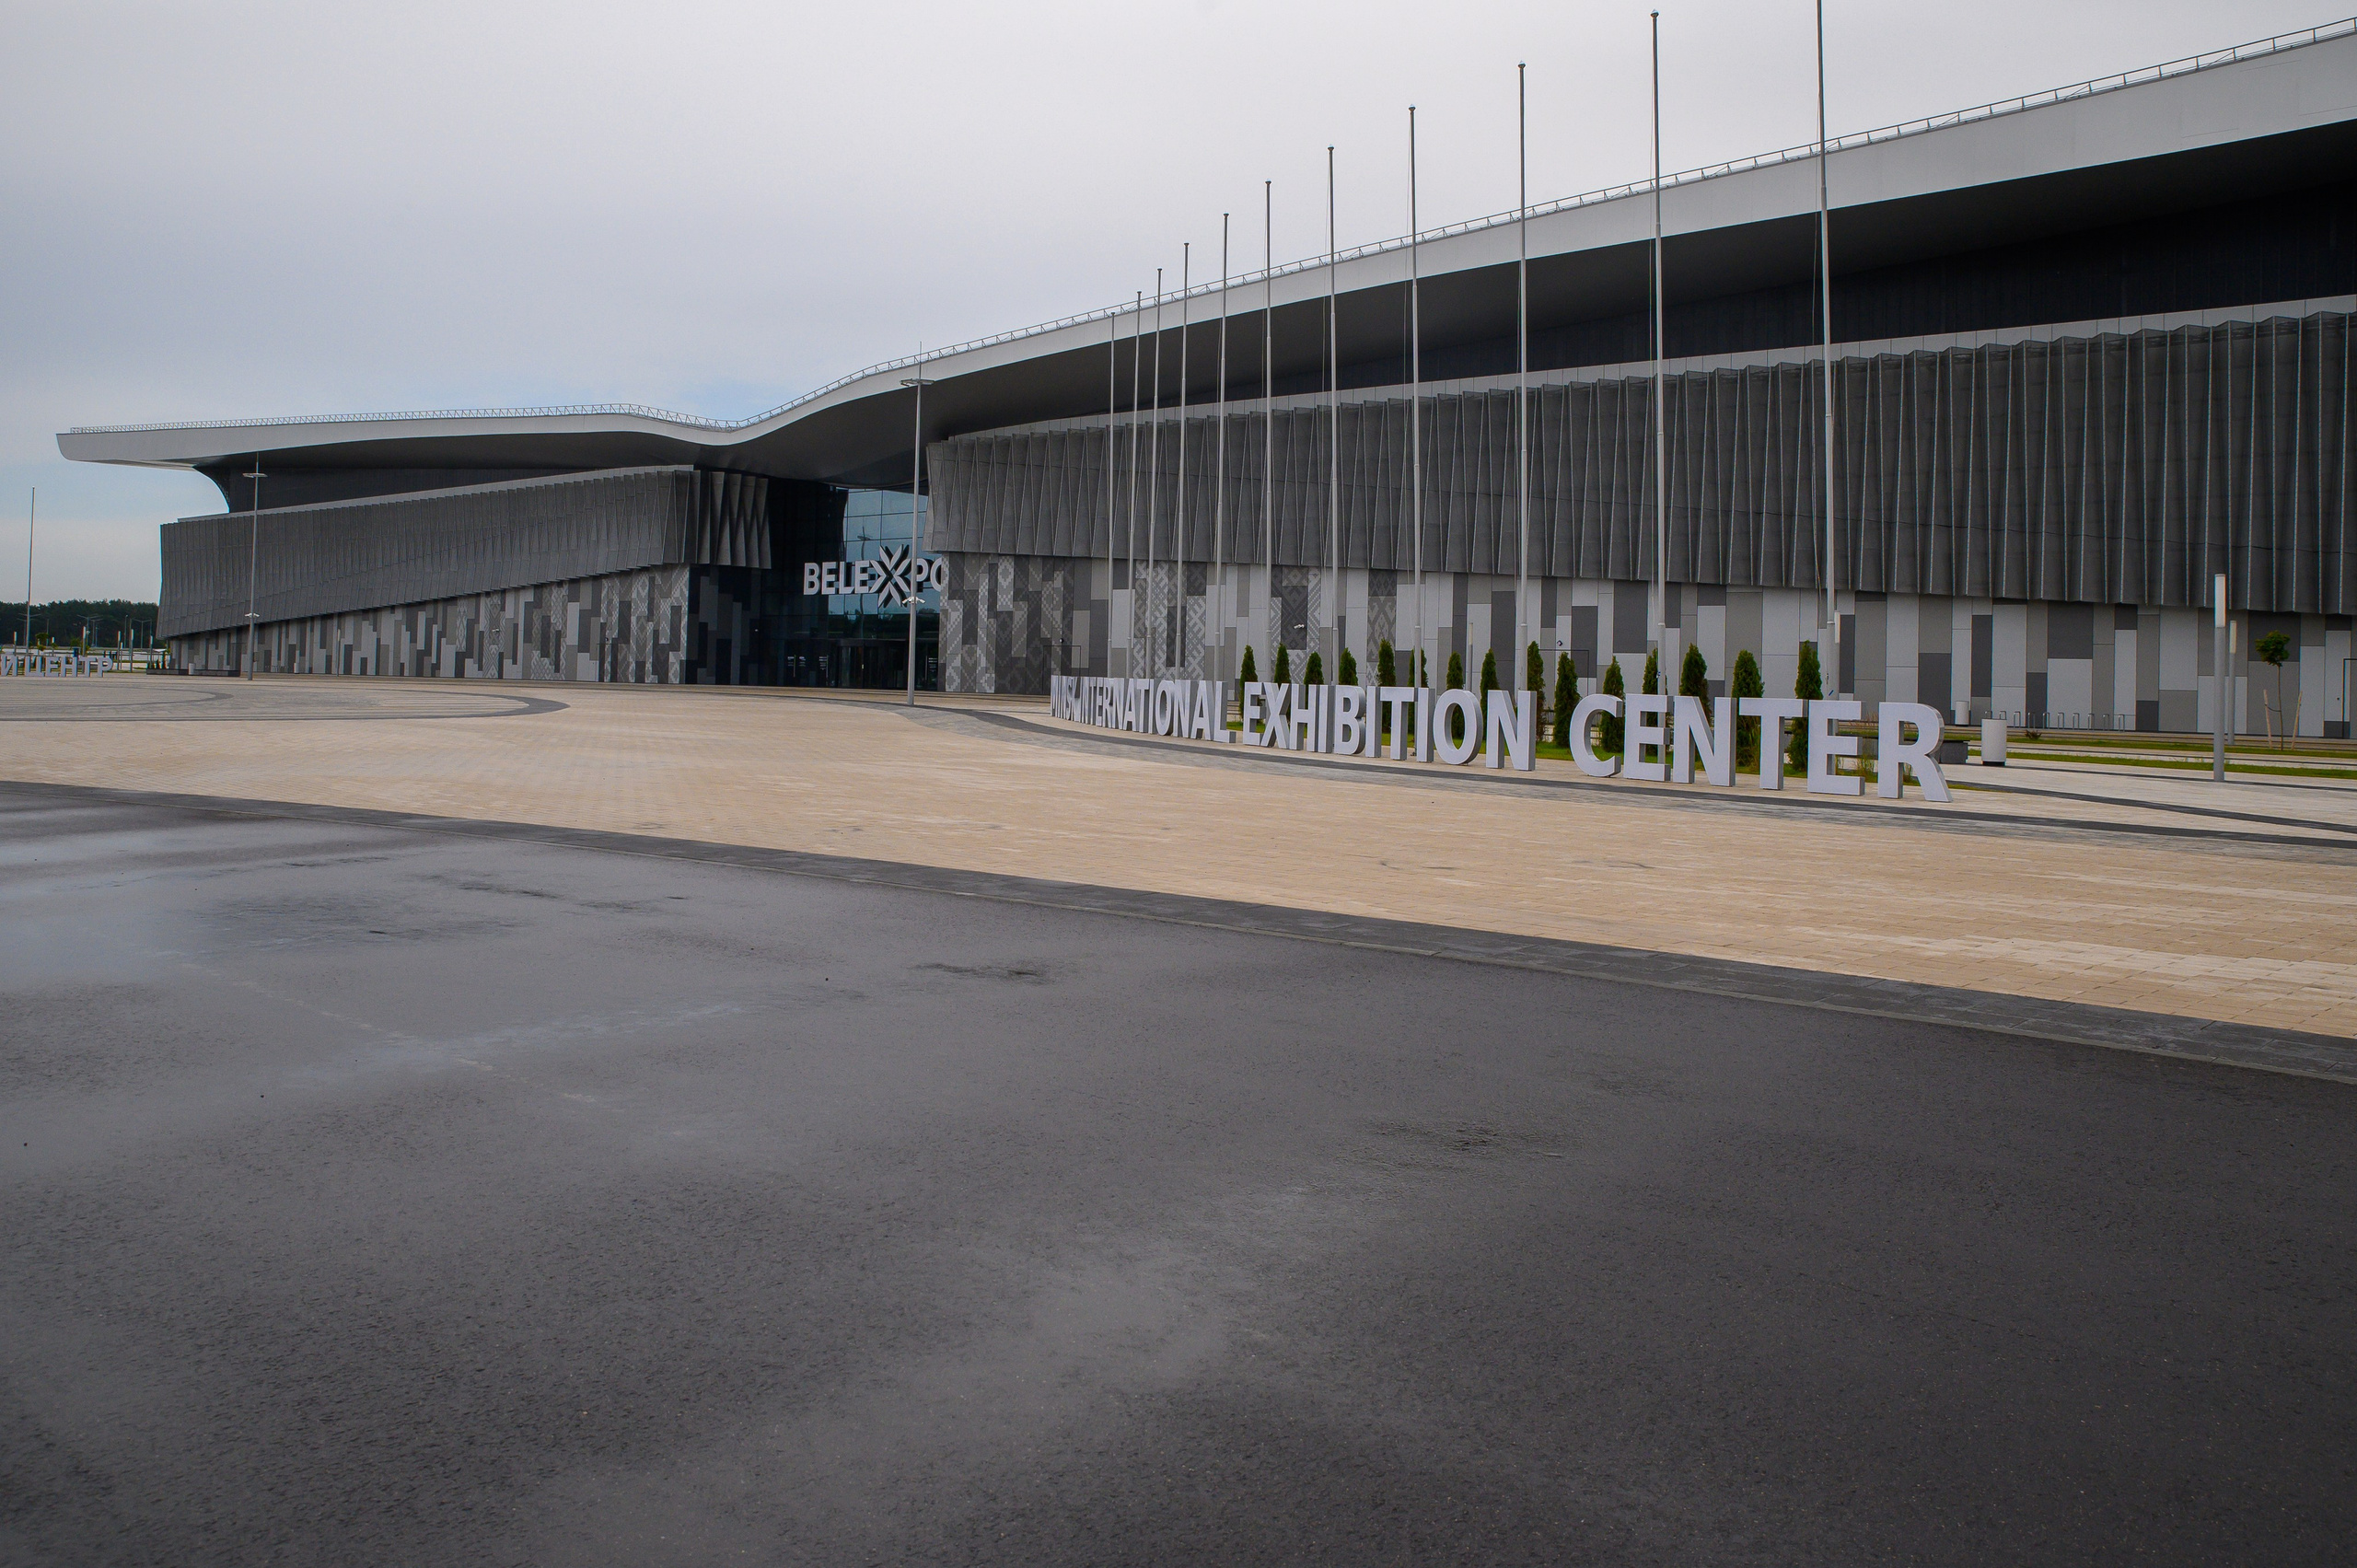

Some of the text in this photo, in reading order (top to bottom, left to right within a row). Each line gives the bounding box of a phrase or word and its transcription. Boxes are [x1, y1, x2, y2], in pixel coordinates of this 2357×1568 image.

[24, 656, 112, 678] ЦЕНТР
[1079, 677, 1236, 743] INTERNATIONAL
[1243, 681, 1536, 771] EXHIBITION
[1569, 692, 1953, 803] CENTER
